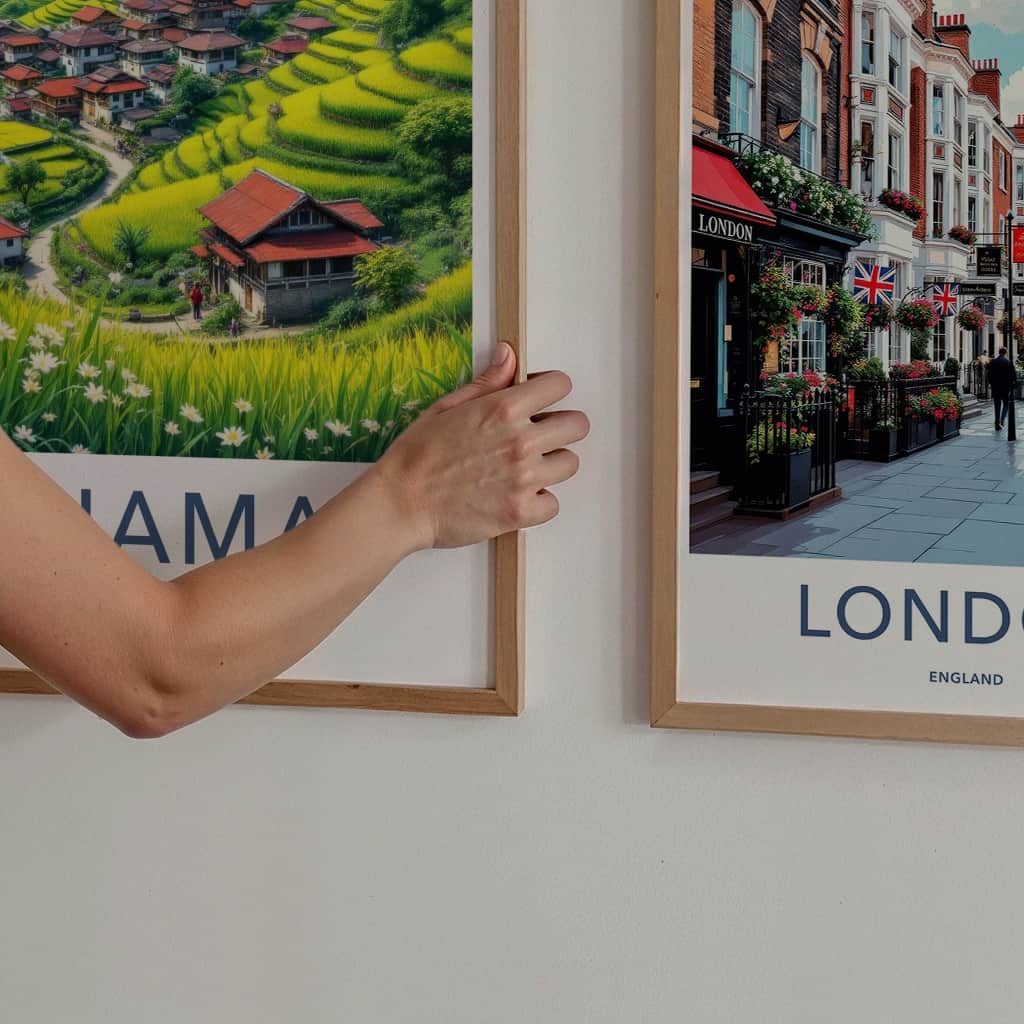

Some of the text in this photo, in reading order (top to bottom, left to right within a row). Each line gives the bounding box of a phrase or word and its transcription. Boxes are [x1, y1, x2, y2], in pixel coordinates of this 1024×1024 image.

[698, 213, 753, 242] LONDON
[800, 584, 1024, 645] LOND
[929, 671, 1004, 686] ENGLAND
